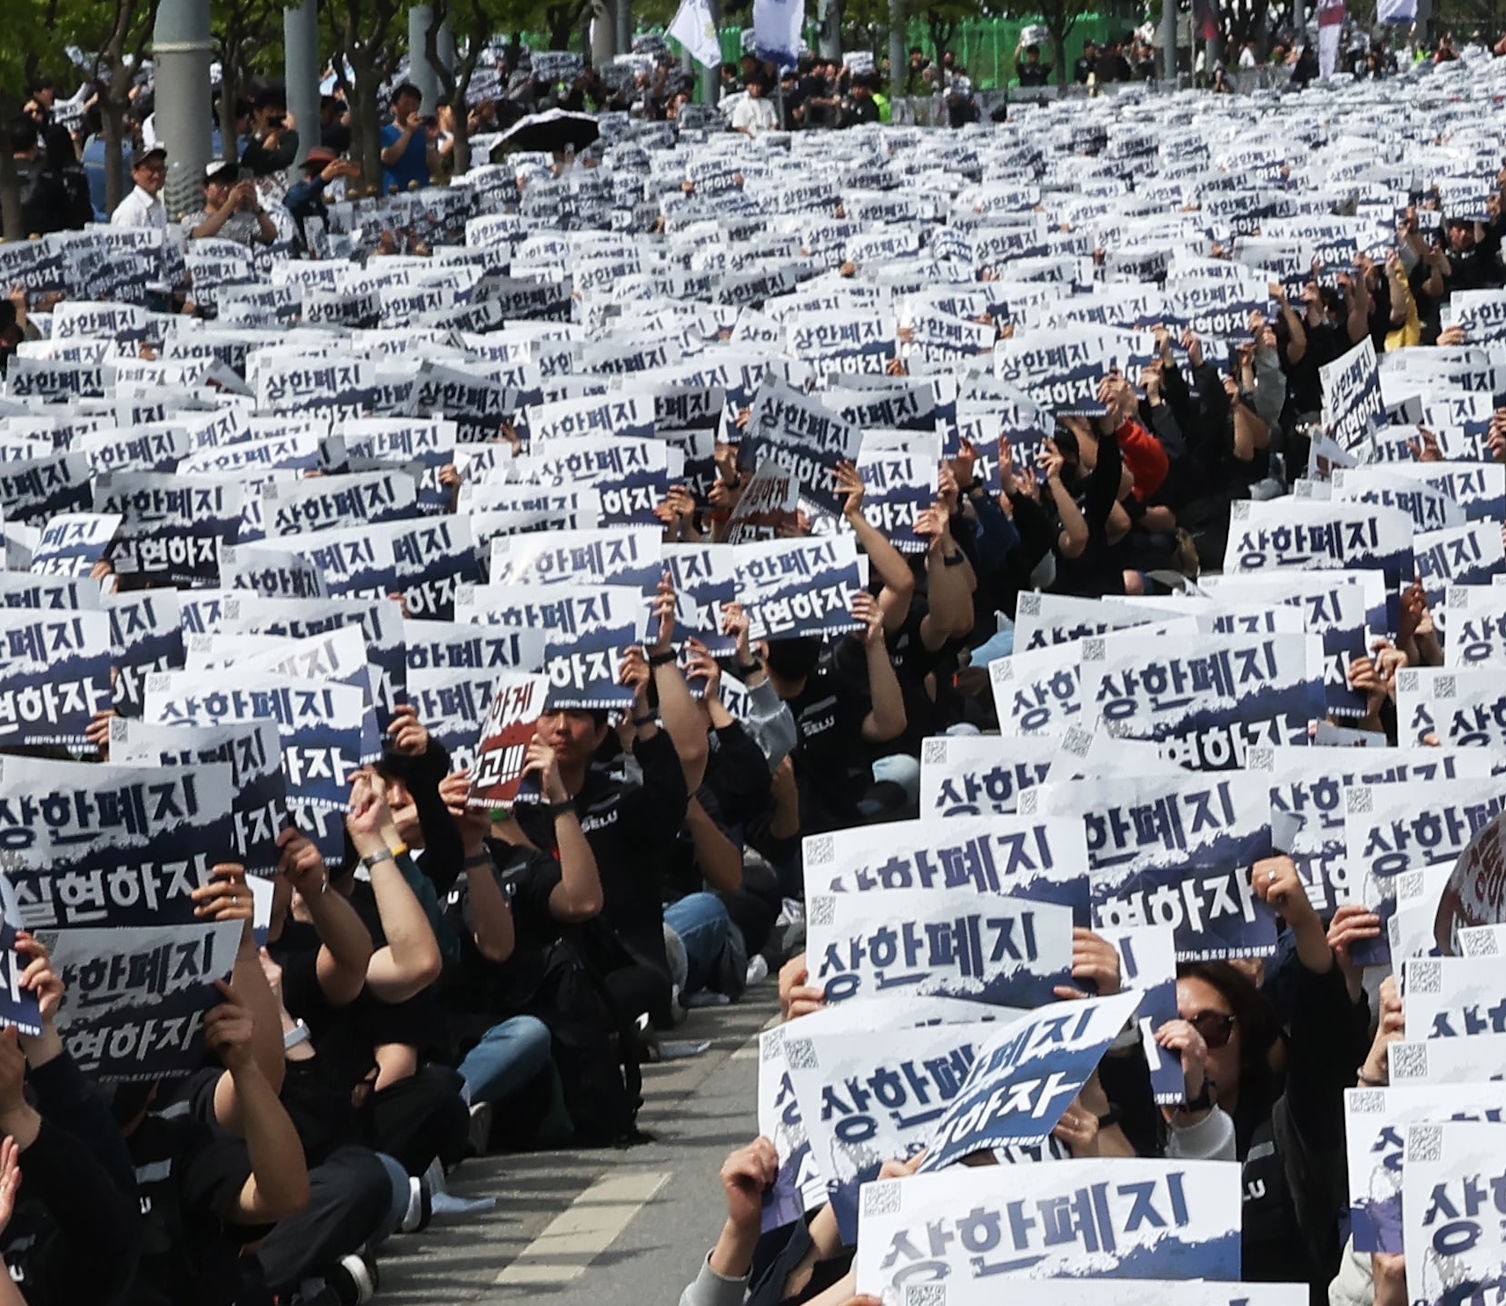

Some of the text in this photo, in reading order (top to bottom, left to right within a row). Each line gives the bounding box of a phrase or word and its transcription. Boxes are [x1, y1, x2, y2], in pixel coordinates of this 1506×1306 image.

[265, 363, 361, 399] 상한폐지
[1000, 343, 1089, 381] 상한폐지
[759, 399, 849, 452] 상한폐지
[541, 445, 649, 487] 상한폐지
[41, 519, 98, 546] 폐지
[275, 476, 395, 536] 상한폐지
[111, 536, 223, 573] 실현하자
[1236, 518, 1378, 568] 상한폐지
[1416, 531, 1481, 584] 폐지
[548, 648, 627, 690] 하자
[1011, 664, 1080, 730] 상한
[1096, 641, 1278, 720] 상한폐지
[0, 775, 198, 850] 상한폐지
[1088, 781, 1236, 869] 한폐지
[12, 853, 216, 929] 실현하자
[820, 913, 1038, 1001] 상한폐지
[62, 1010, 206, 1072] 현하자
[883, 1171, 1189, 1282] 상한폐지
